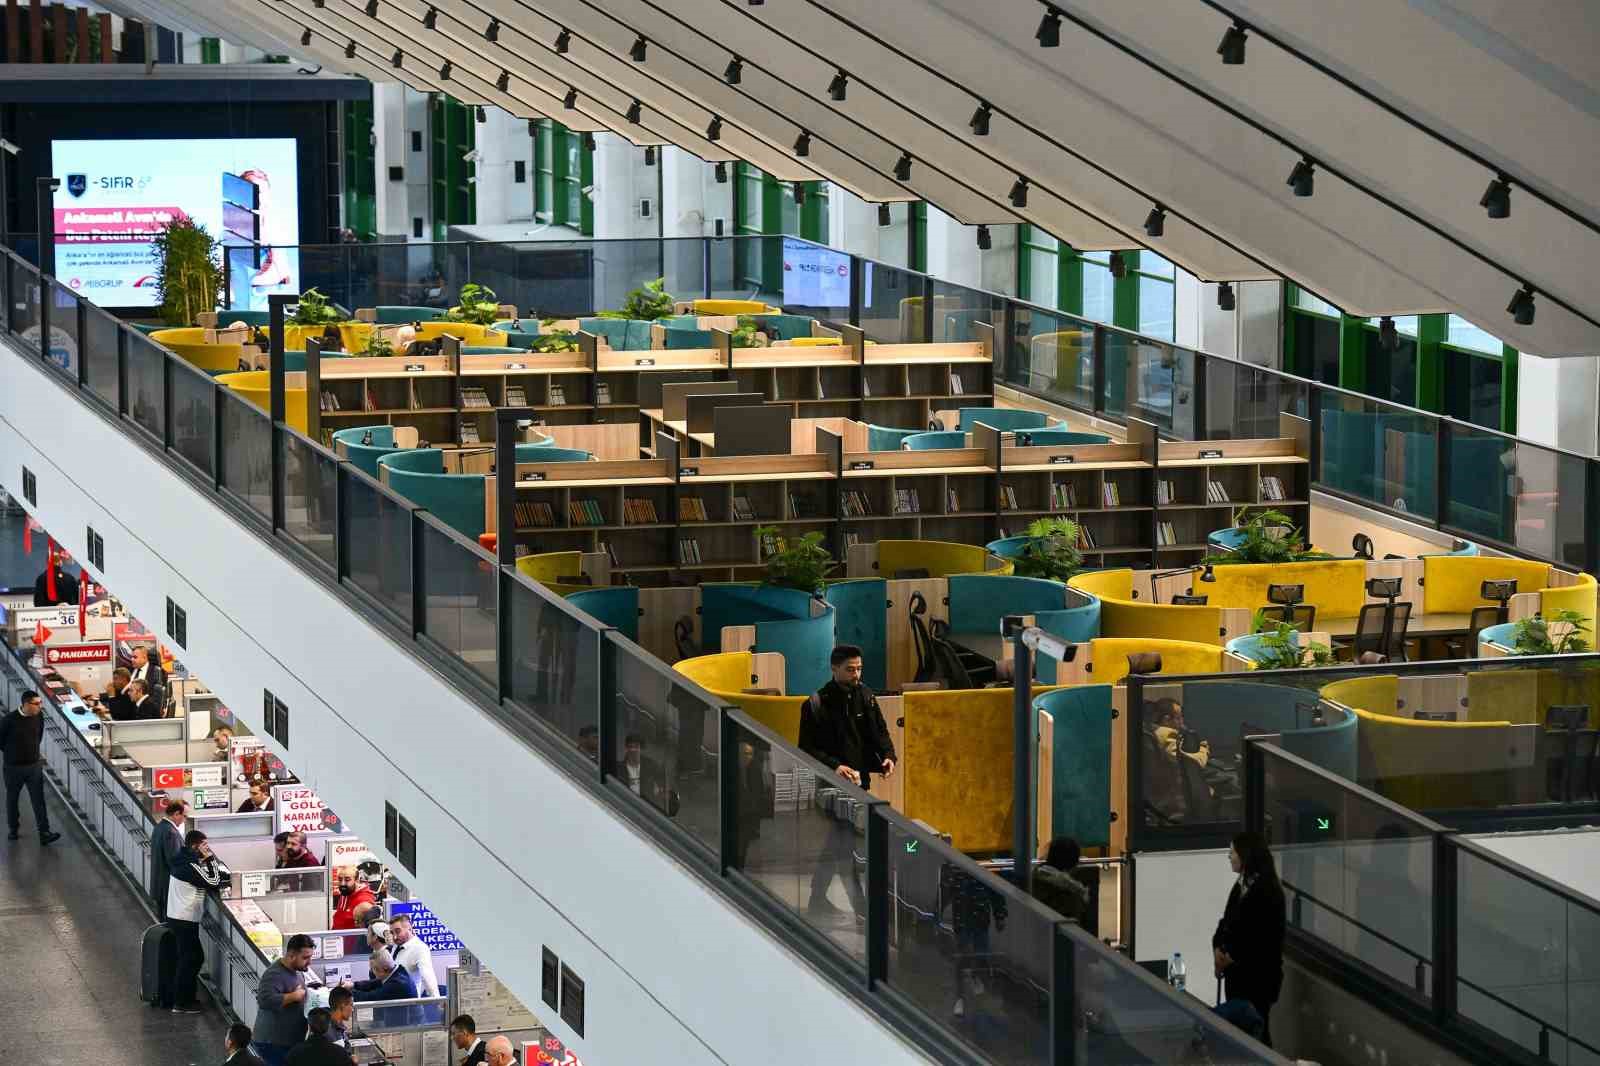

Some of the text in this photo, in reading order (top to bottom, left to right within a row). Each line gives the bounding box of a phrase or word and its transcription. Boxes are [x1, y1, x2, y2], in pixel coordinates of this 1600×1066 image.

[60, 615, 76, 625] 36
[60, 649, 109, 659] PAMUKKALE
[284, 812, 322, 822] KARAM
[461, 954, 472, 965] 51
